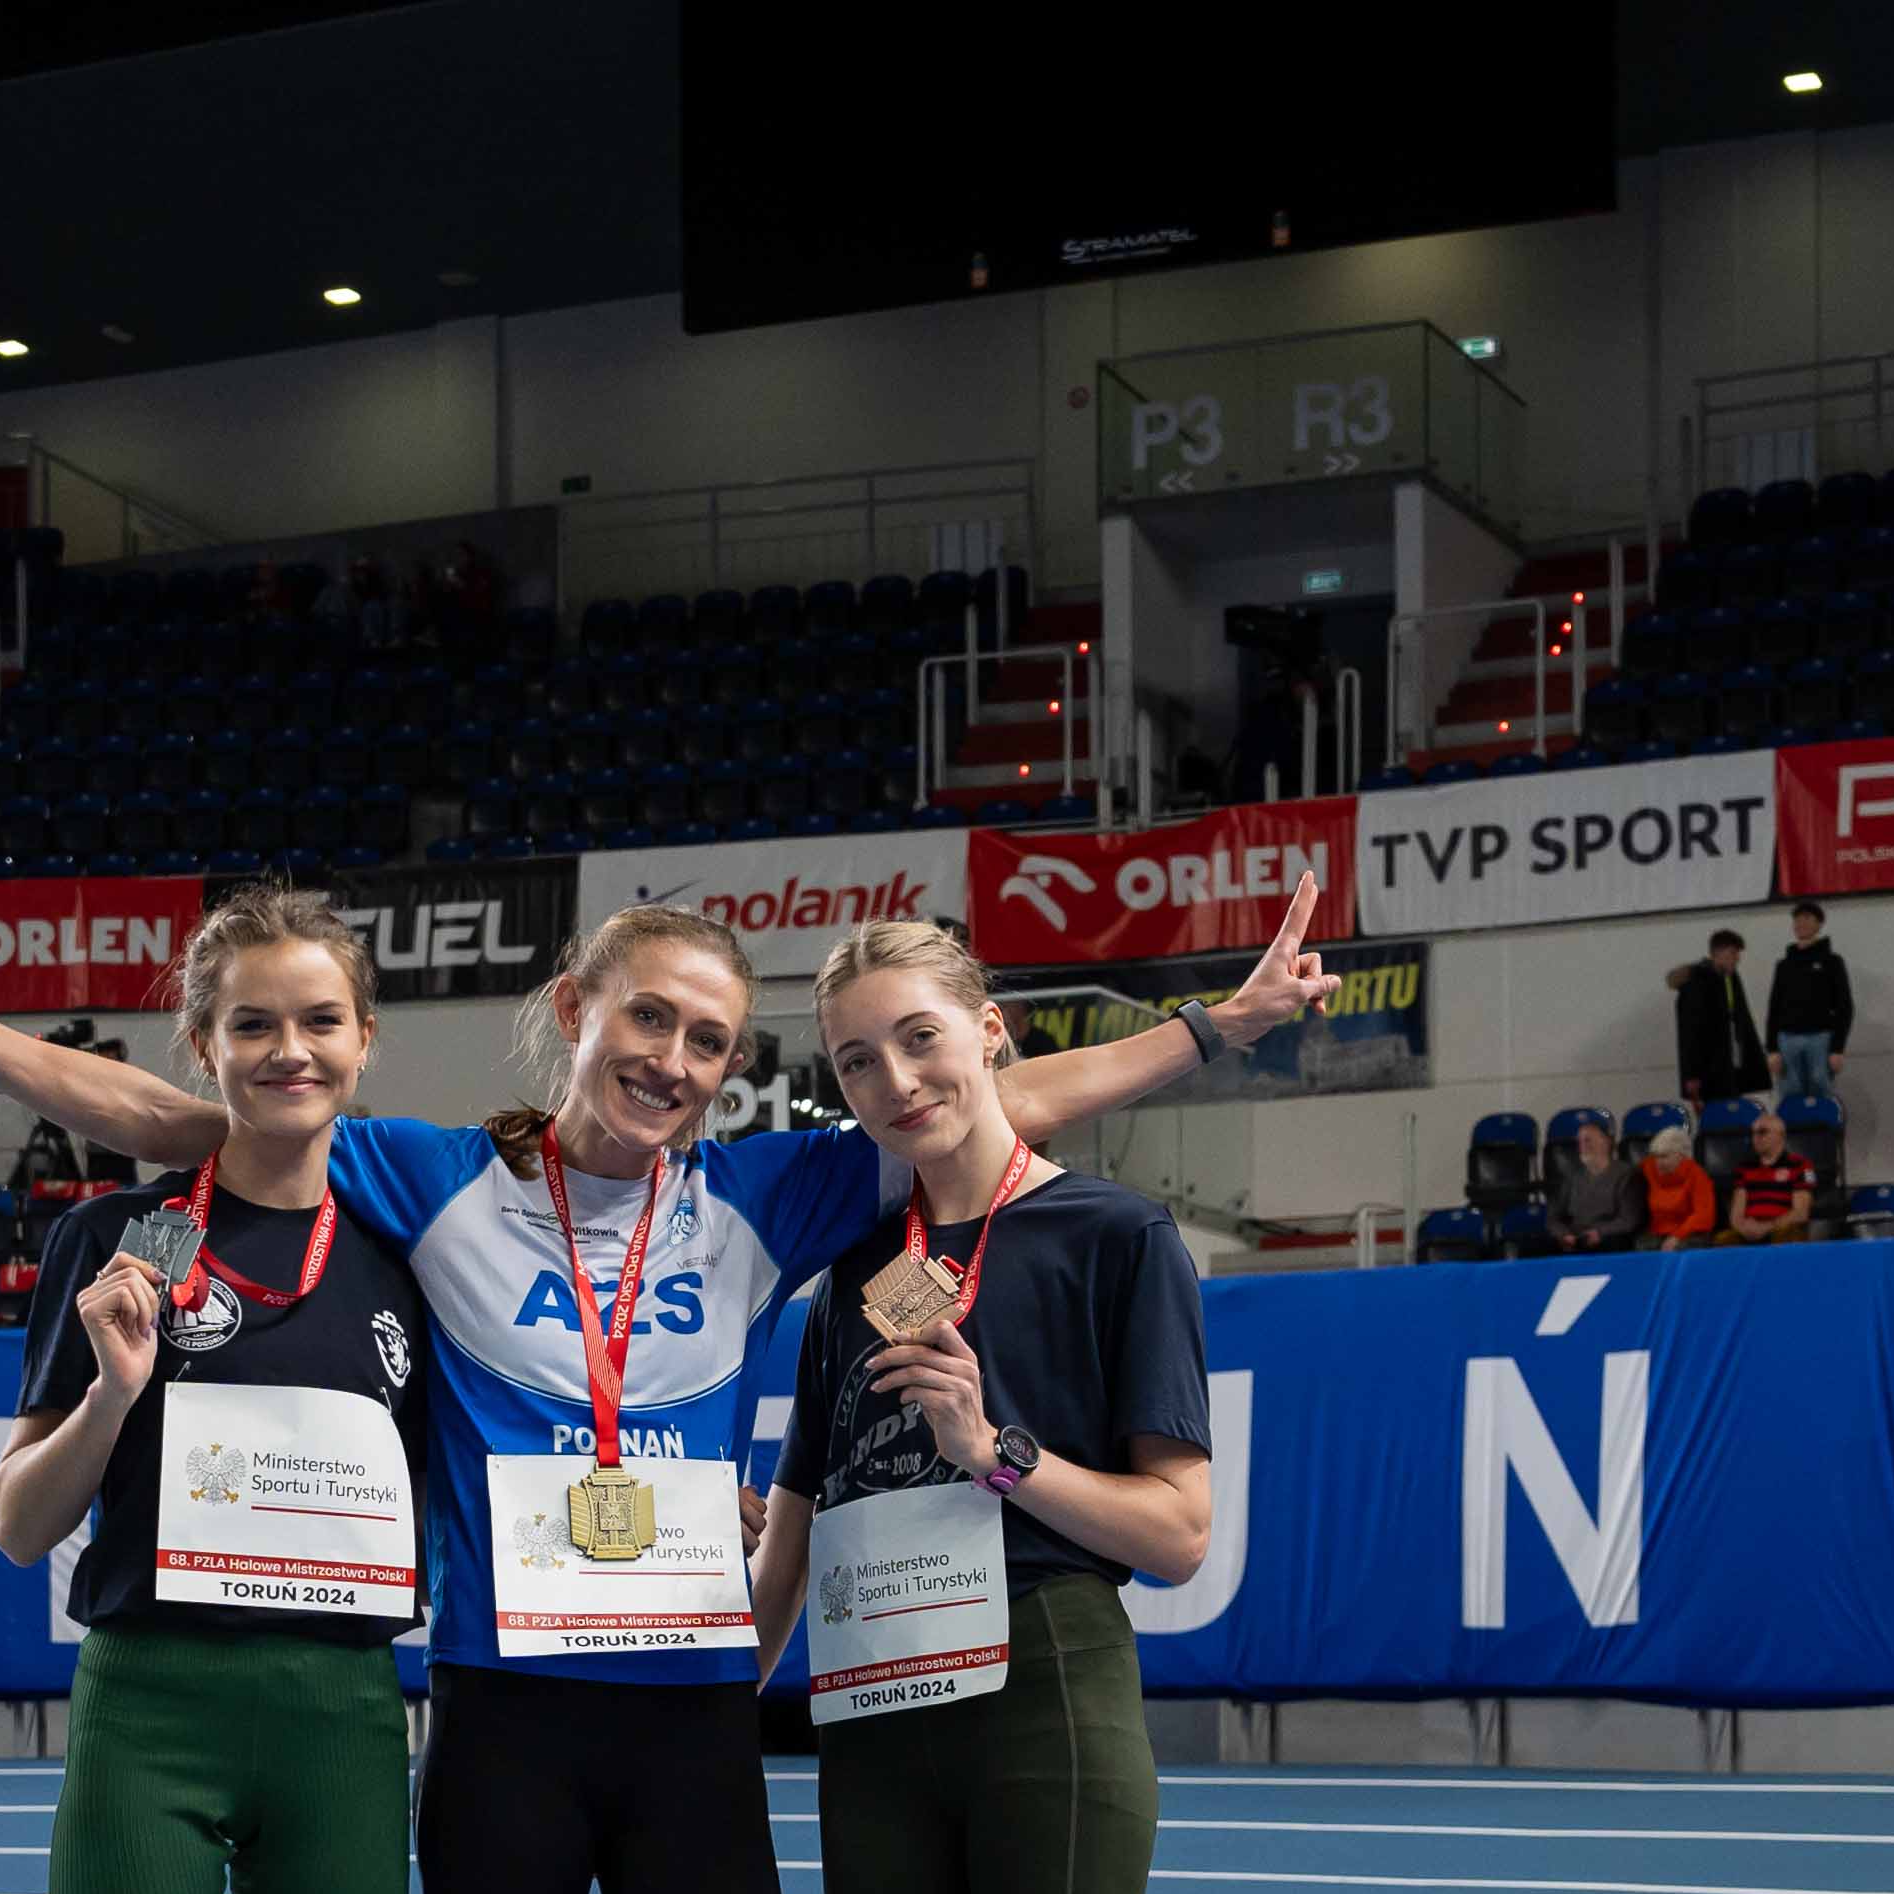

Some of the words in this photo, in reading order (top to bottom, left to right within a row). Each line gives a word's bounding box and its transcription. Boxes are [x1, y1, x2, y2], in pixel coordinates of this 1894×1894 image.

[1294, 375, 1394, 451] R3
[1131, 397, 1224, 470] P3
[1372, 823, 1509, 888] TVP
[1530, 796, 1765, 875] SPORT
[1115, 842, 1328, 910] ORLEN
[703, 869, 929, 932] polanik
[1287, 962, 1421, 1022] ORTU
[513, 1269, 705, 1335] AZS
[554, 1418, 684, 1458] PONAŃ
[253, 1452, 366, 1476] Ministerstwo
[251, 1474, 309, 1495] Sportu
[326, 1480, 398, 1503] Turystyki
[169, 1553, 191, 1567] 68.
[194, 1556, 226, 1569] PZLA
[229, 1558, 282, 1573] Halowe
[285, 1562, 367, 1580] Mistrzostwa
[370, 1568, 407, 1583] Polski
[857, 1553, 949, 1581] Ministerstwo
[858, 1581, 901, 1604] Sportu
[913, 1567, 988, 1592] Turystyki
[220, 1580, 298, 1602] TORUŃ
[303, 1586, 356, 1606] 2024
[508, 1614, 529, 1627] 68.
[531, 1615, 564, 1627] PZLA
[566, 1616, 617, 1627] Halowe
[621, 1615, 702, 1627] Mistrzostwa
[705, 1614, 744, 1626] Polski
[560, 1631, 638, 1647] TORUŃ
[642, 1632, 697, 1646] 2024
[833, 1676, 853, 1687] PZLA
[855, 1667, 891, 1683] Halowe
[893, 1655, 964, 1675] Mistrzostwa
[966, 1648, 1001, 1665] Polski
[850, 1682, 907, 1710] TORUŃ
[910, 1679, 957, 1700] 2024
